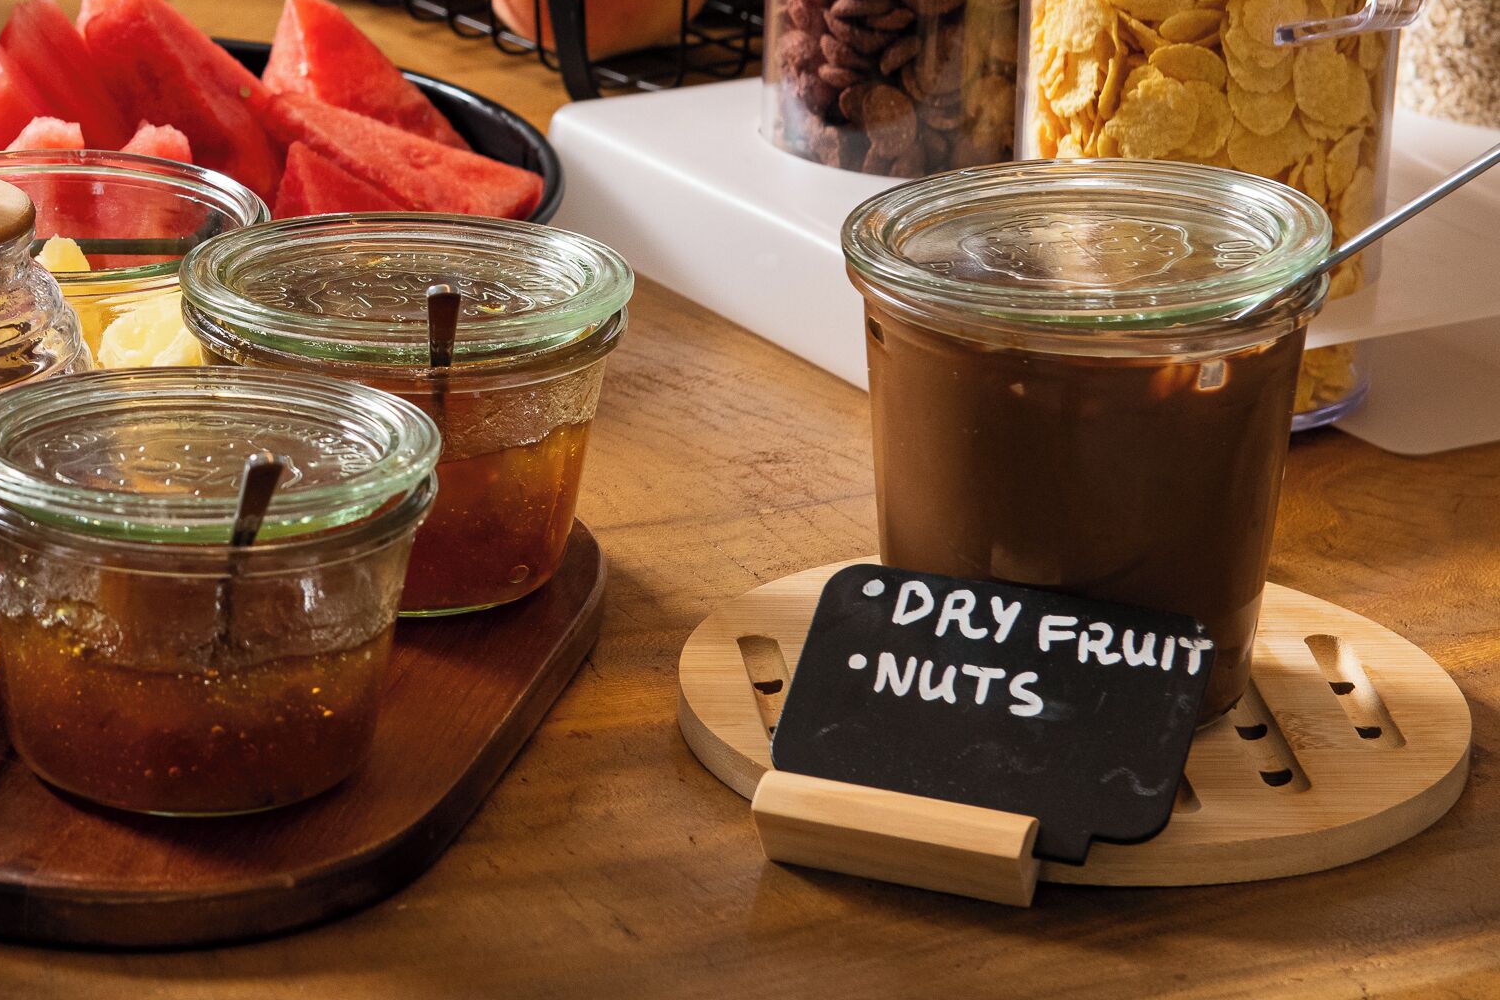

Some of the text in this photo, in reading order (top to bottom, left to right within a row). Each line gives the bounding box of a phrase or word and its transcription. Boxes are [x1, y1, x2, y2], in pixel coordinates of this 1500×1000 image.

[892, 580, 1213, 674] DRY FRUIT
[874, 653, 1045, 717] NUTS
